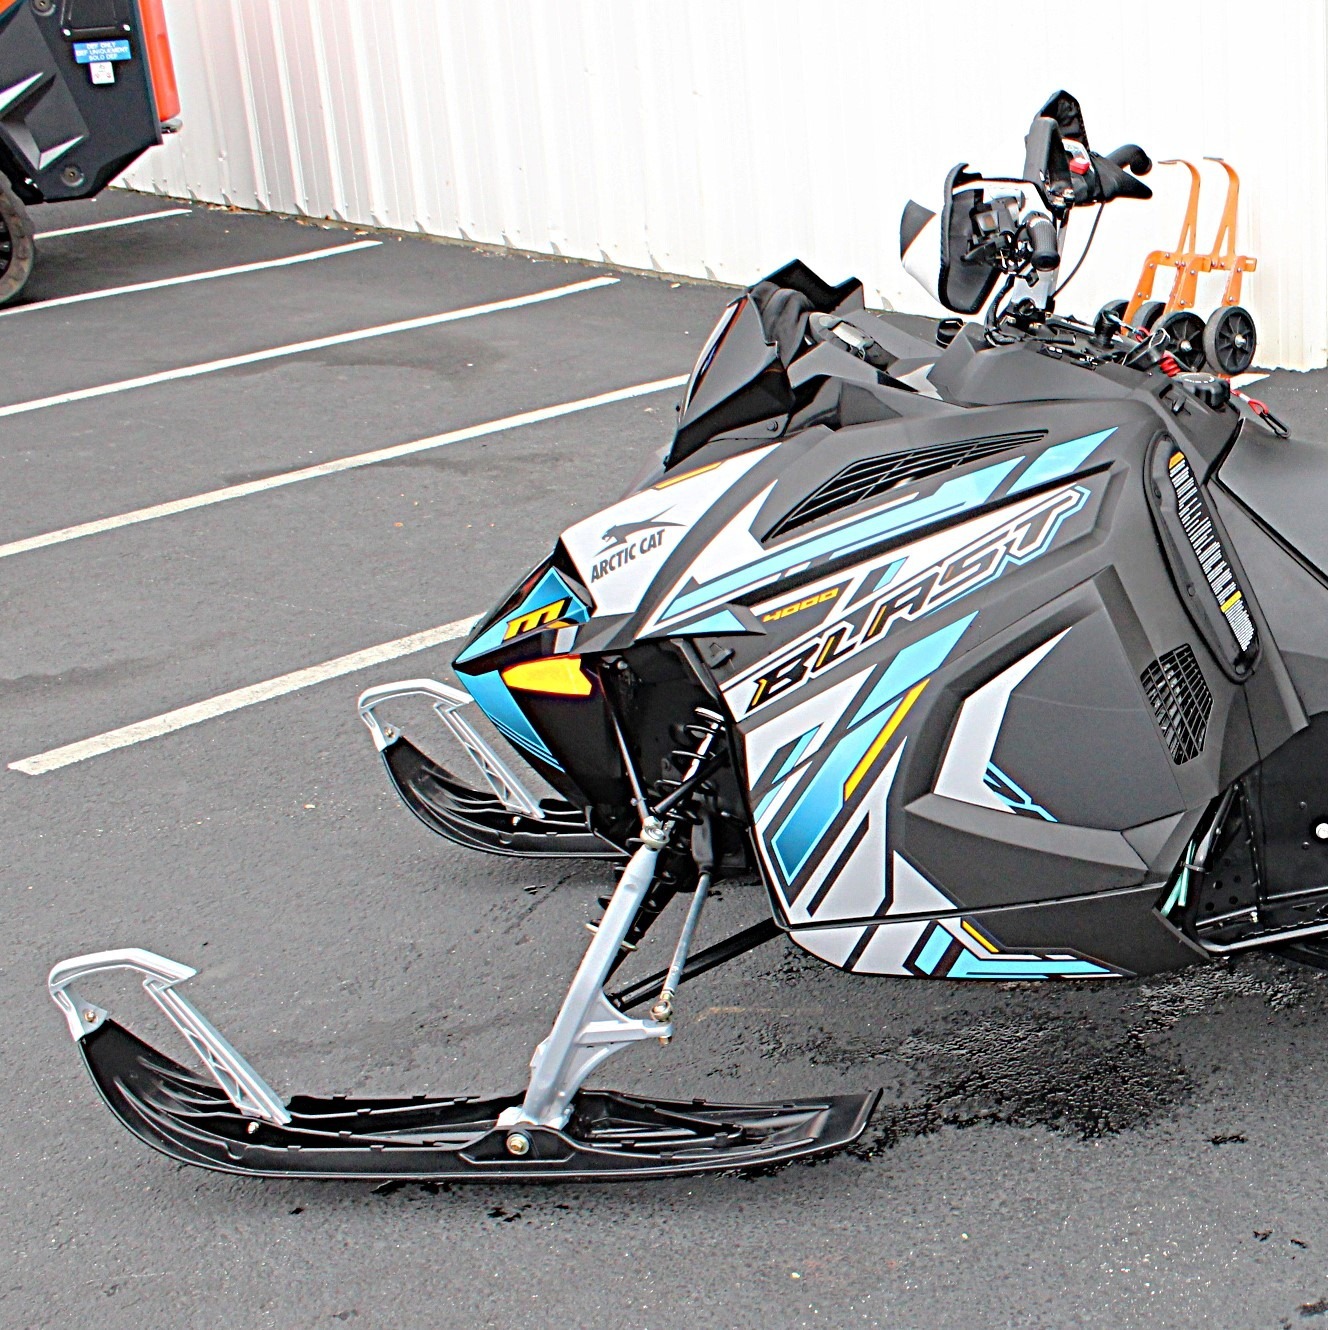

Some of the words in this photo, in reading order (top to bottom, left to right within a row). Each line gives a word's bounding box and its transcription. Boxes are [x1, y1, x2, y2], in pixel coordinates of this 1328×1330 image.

[591, 542, 637, 583] ARCTIC
[639, 528, 665, 554] CAT
[744, 489, 1082, 716] BLAST
[762, 587, 839, 623] 4000
